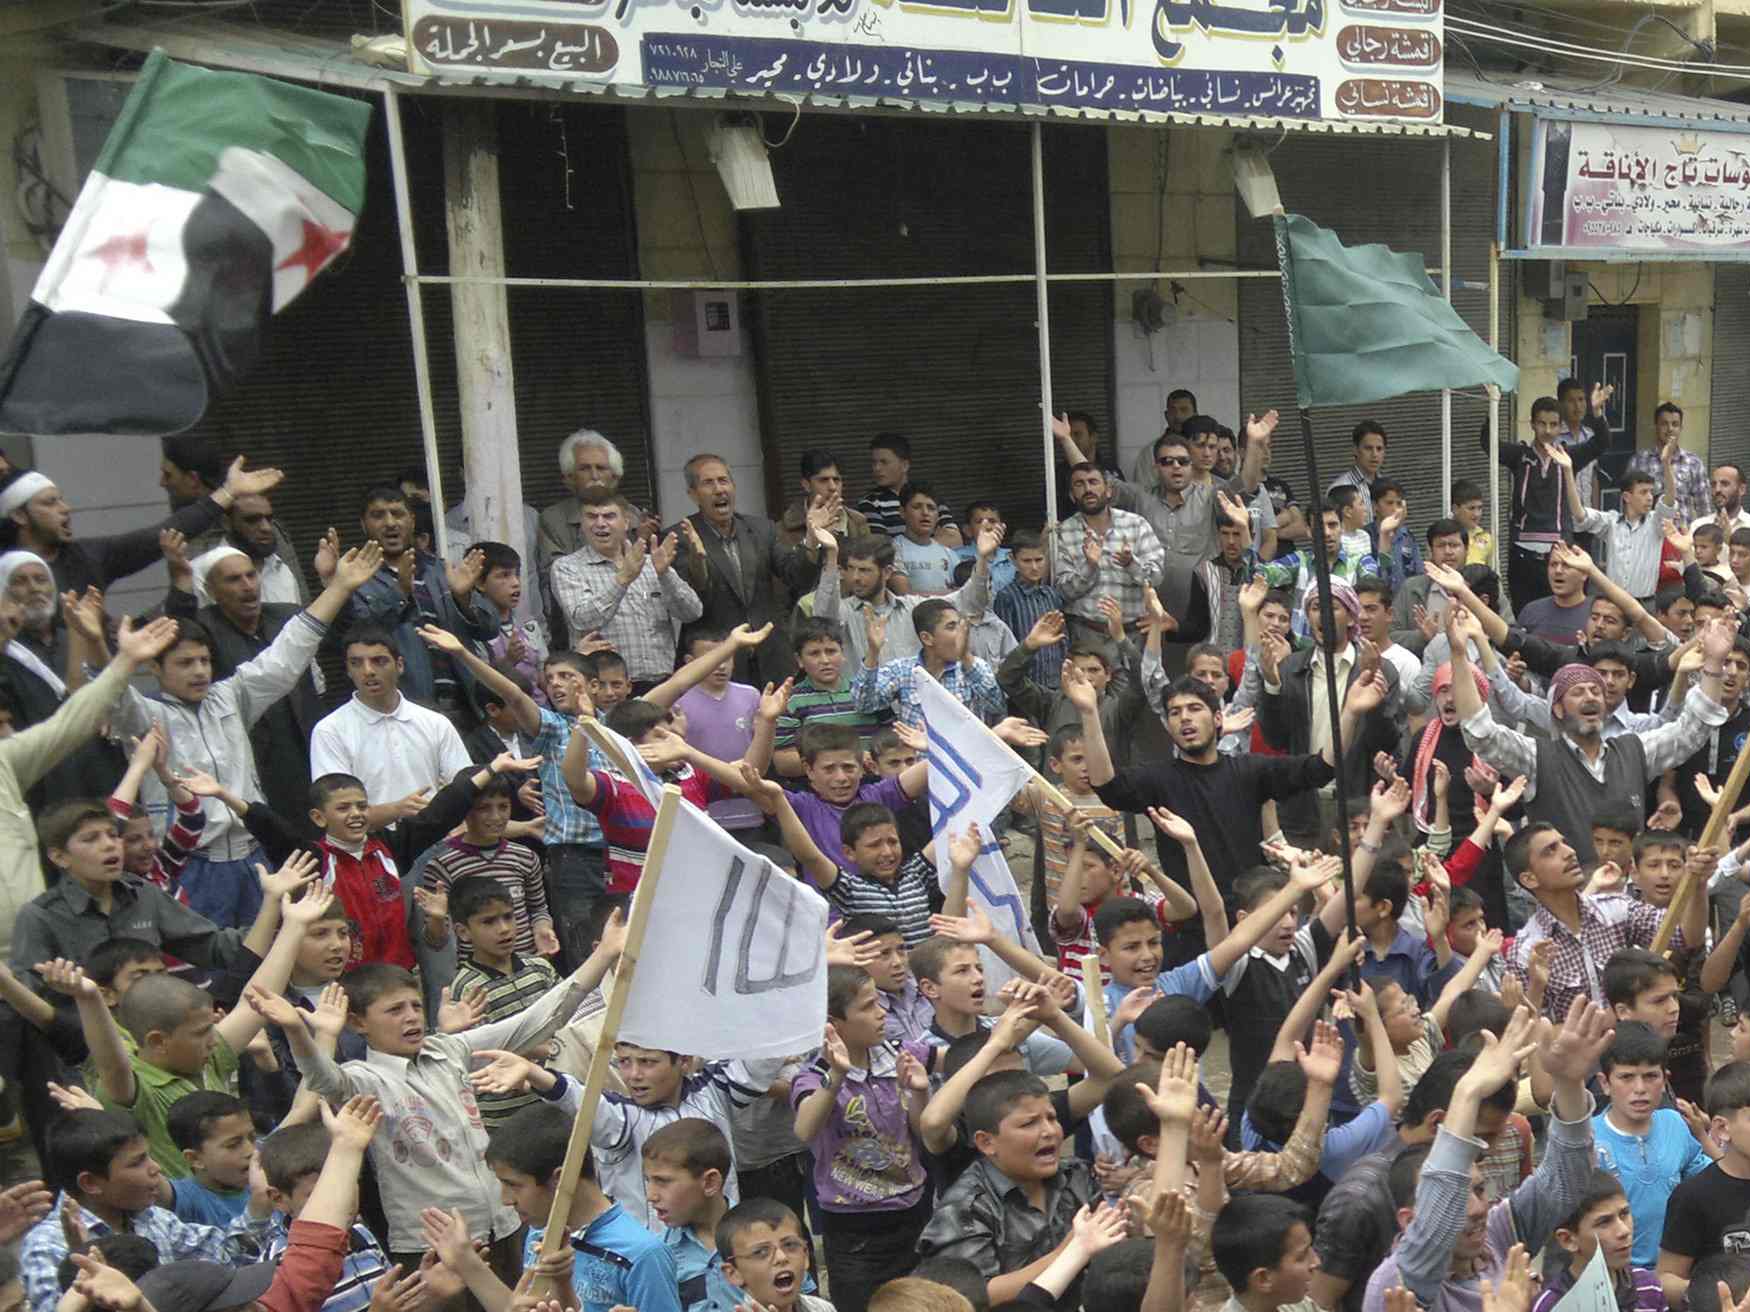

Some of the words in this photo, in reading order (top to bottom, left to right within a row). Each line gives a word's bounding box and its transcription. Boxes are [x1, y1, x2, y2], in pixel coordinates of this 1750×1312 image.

[426, 21, 490, 61] الجملة
[489, 29, 545, 59] بسعر
[549, 29, 600, 70] البيع
[1346, 26, 1388, 63] رجالي
[1664, 156, 1699, 188] تاج
